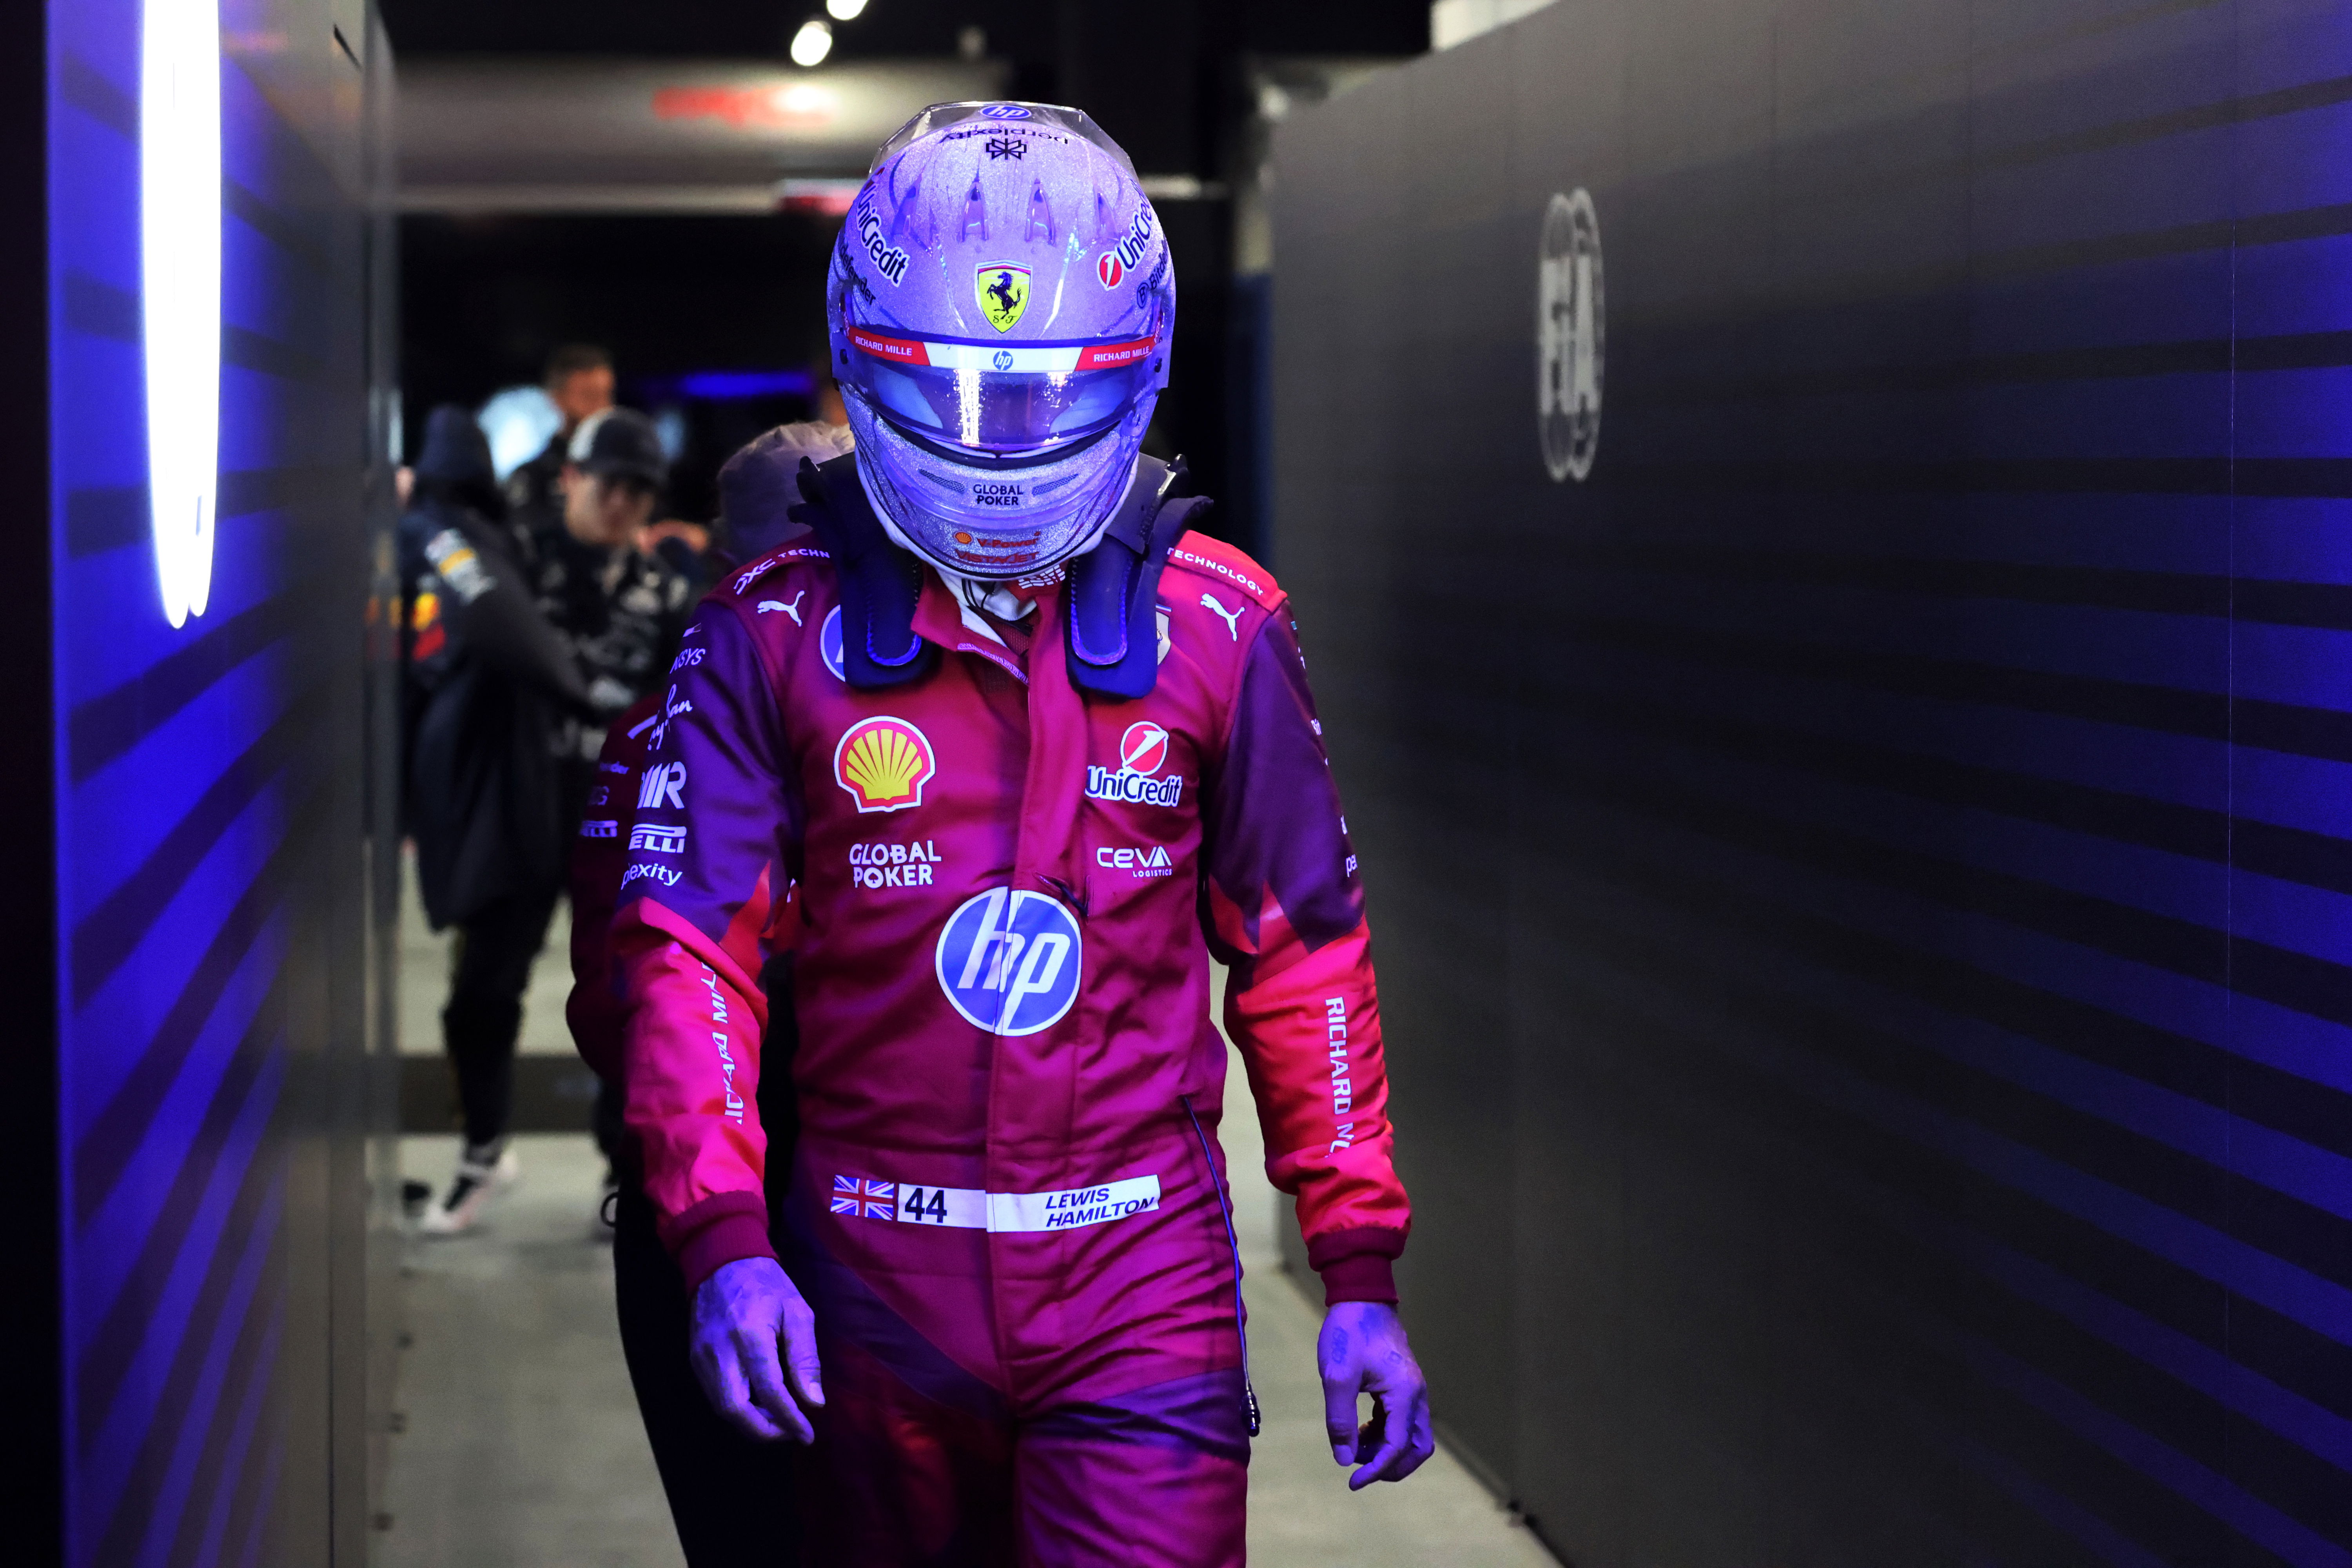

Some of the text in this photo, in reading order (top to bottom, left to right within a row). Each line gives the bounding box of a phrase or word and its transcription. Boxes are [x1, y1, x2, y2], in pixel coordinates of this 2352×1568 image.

[987, 105, 1025, 118] hp
[939, 128, 1068, 145] perplexity
[857, 185, 908, 284] UniCredit
[855, 336, 913, 356] RICHARD MILLE
[1539, 254, 1604, 416] FIA
[995, 350, 1013, 370] hp
[1093, 345, 1150, 362] RICHARD MILLE
[973, 484, 1024, 495] GLOBAL
[976, 495, 1019, 506] POKER
[778, 548, 830, 559] TECHN
[670, 648, 706, 674] NSYS
[1085, 768, 1180, 804] UniCredit
[849, 840, 942, 866] GLOBAL
[853, 864, 933, 889] POKER
[1132, 868, 1172, 878] LOGISTICS
[956, 886, 1071, 1036] hp
[1325, 996, 1352, 1115] RICHARD
[905, 1187, 947, 1224] 44
[1045, 1188, 1109, 1210] LEWIS
[1045, 1197, 1154, 1227] HAMILTON
